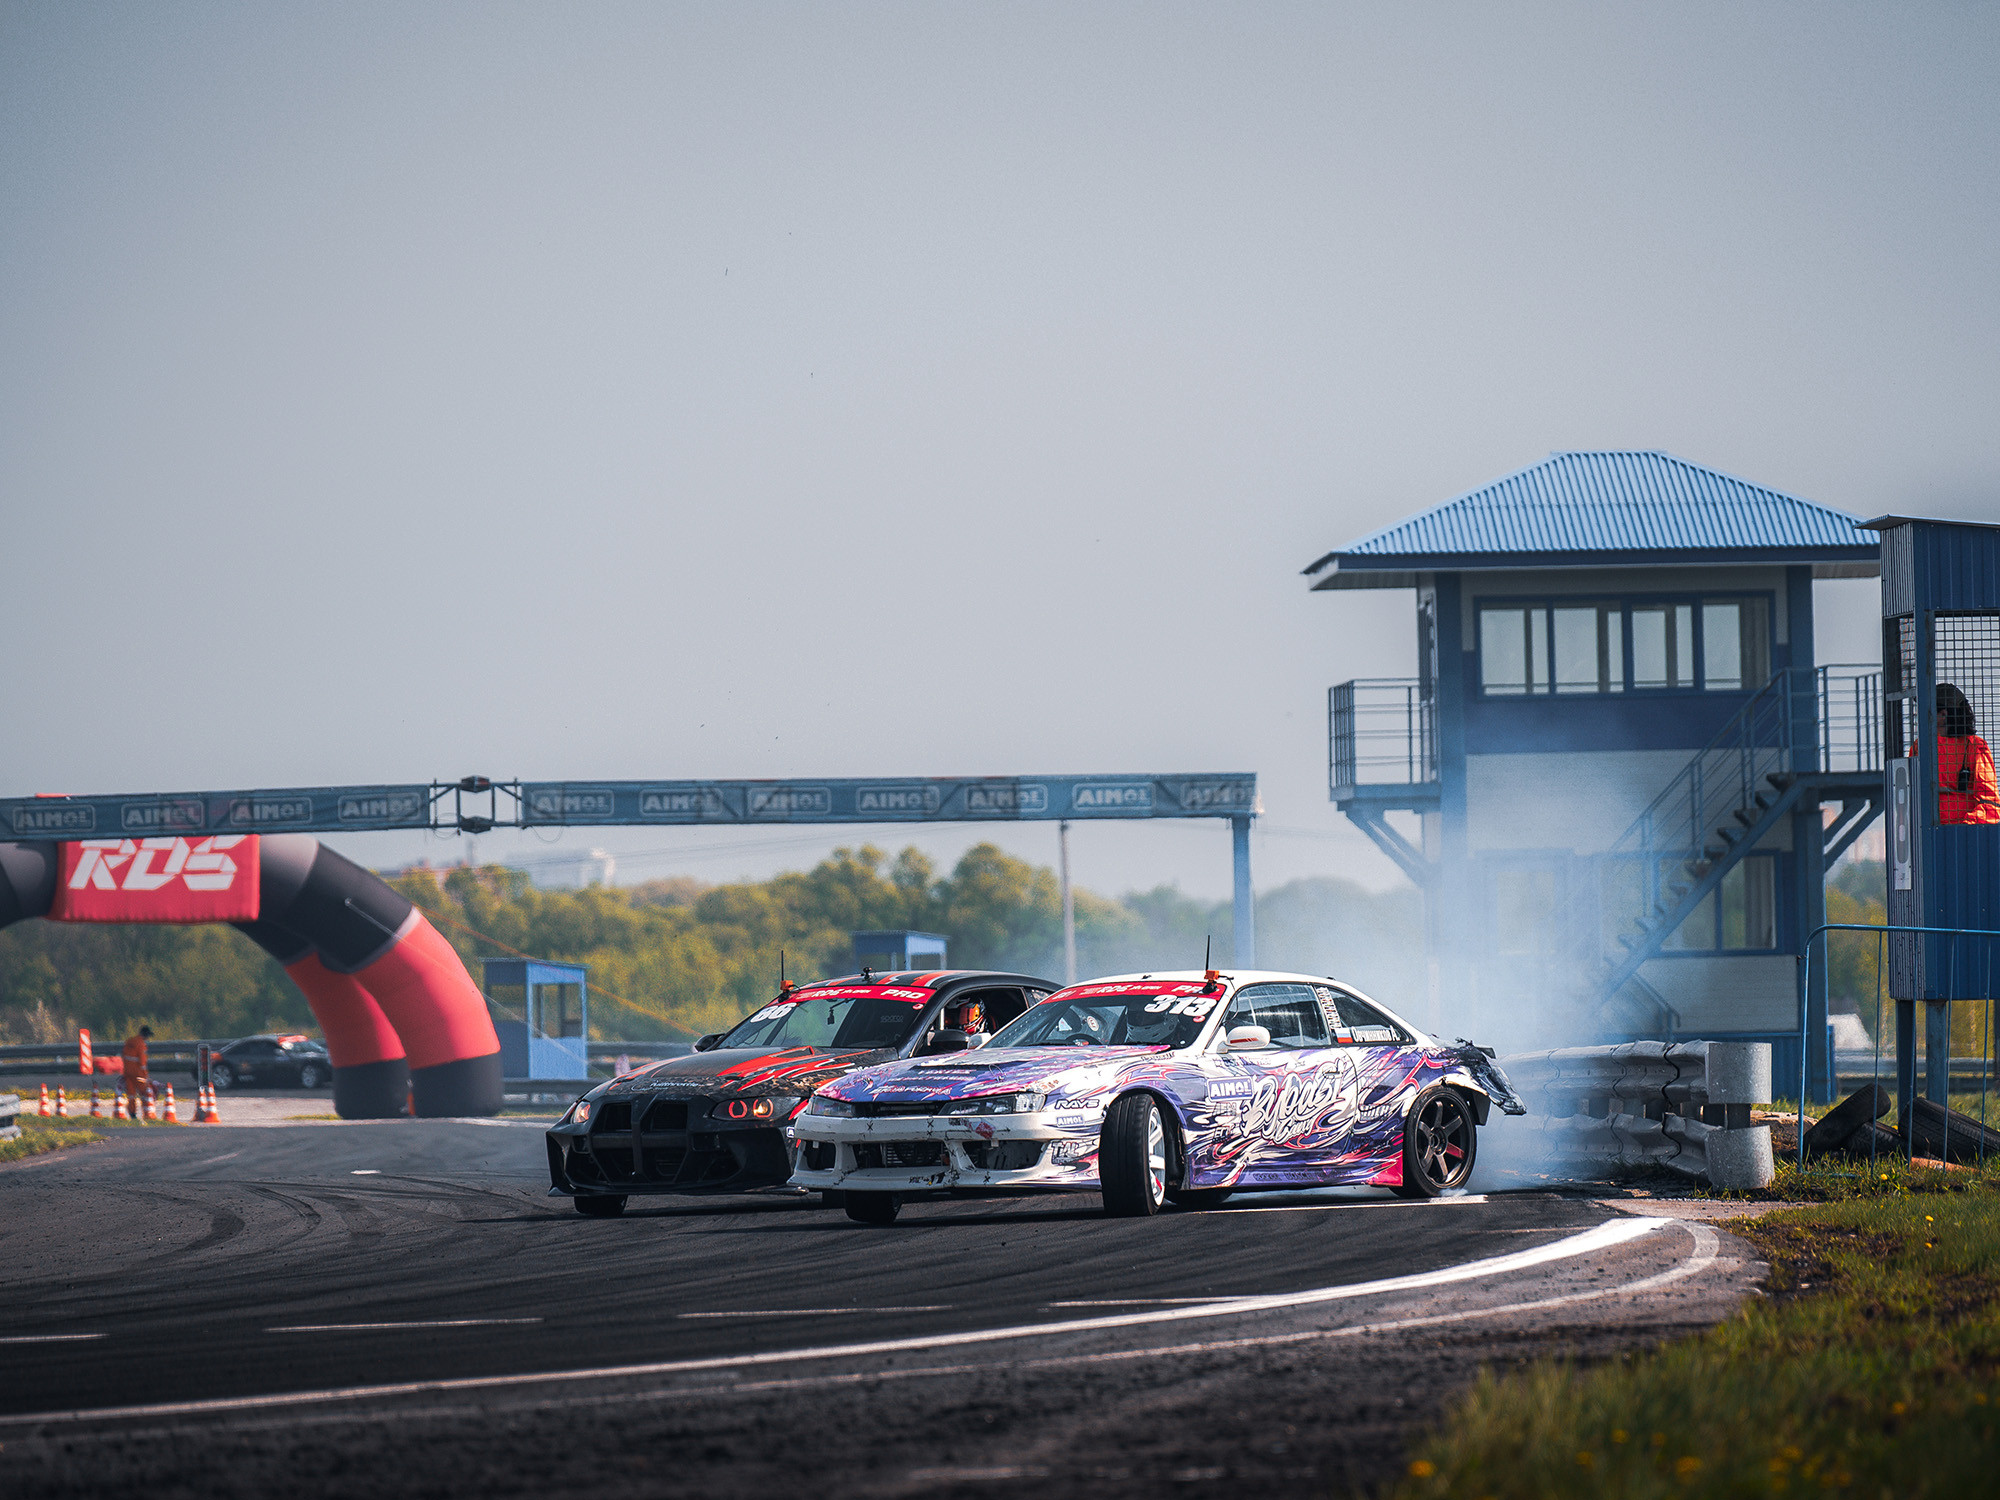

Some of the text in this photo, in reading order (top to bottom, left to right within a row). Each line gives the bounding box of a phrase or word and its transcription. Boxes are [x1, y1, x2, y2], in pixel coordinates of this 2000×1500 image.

[537, 796, 609, 812] AIMOL
[644, 795, 719, 811] AIMOL
[755, 794, 827, 810] AIMOL
[860, 793, 937, 808] AIMOL
[968, 791, 1039, 806] AIMOL
[1079, 789, 1150, 805] AIMOL
[125, 806, 200, 825] AIMOL
[234, 803, 306, 821] AIMOL
[343, 799, 417, 817] AIMOL
[17, 810, 91, 828] AIMOL
[68, 834, 239, 891] RDS
[881, 988, 925, 999] PRO
[1144, 994, 1218, 1017] 313
[1210, 1081, 1252, 1098] AIMOL
[1054, 1098, 1100, 1109] RAYS
[1058, 1116, 1083, 1125] AIMOL
